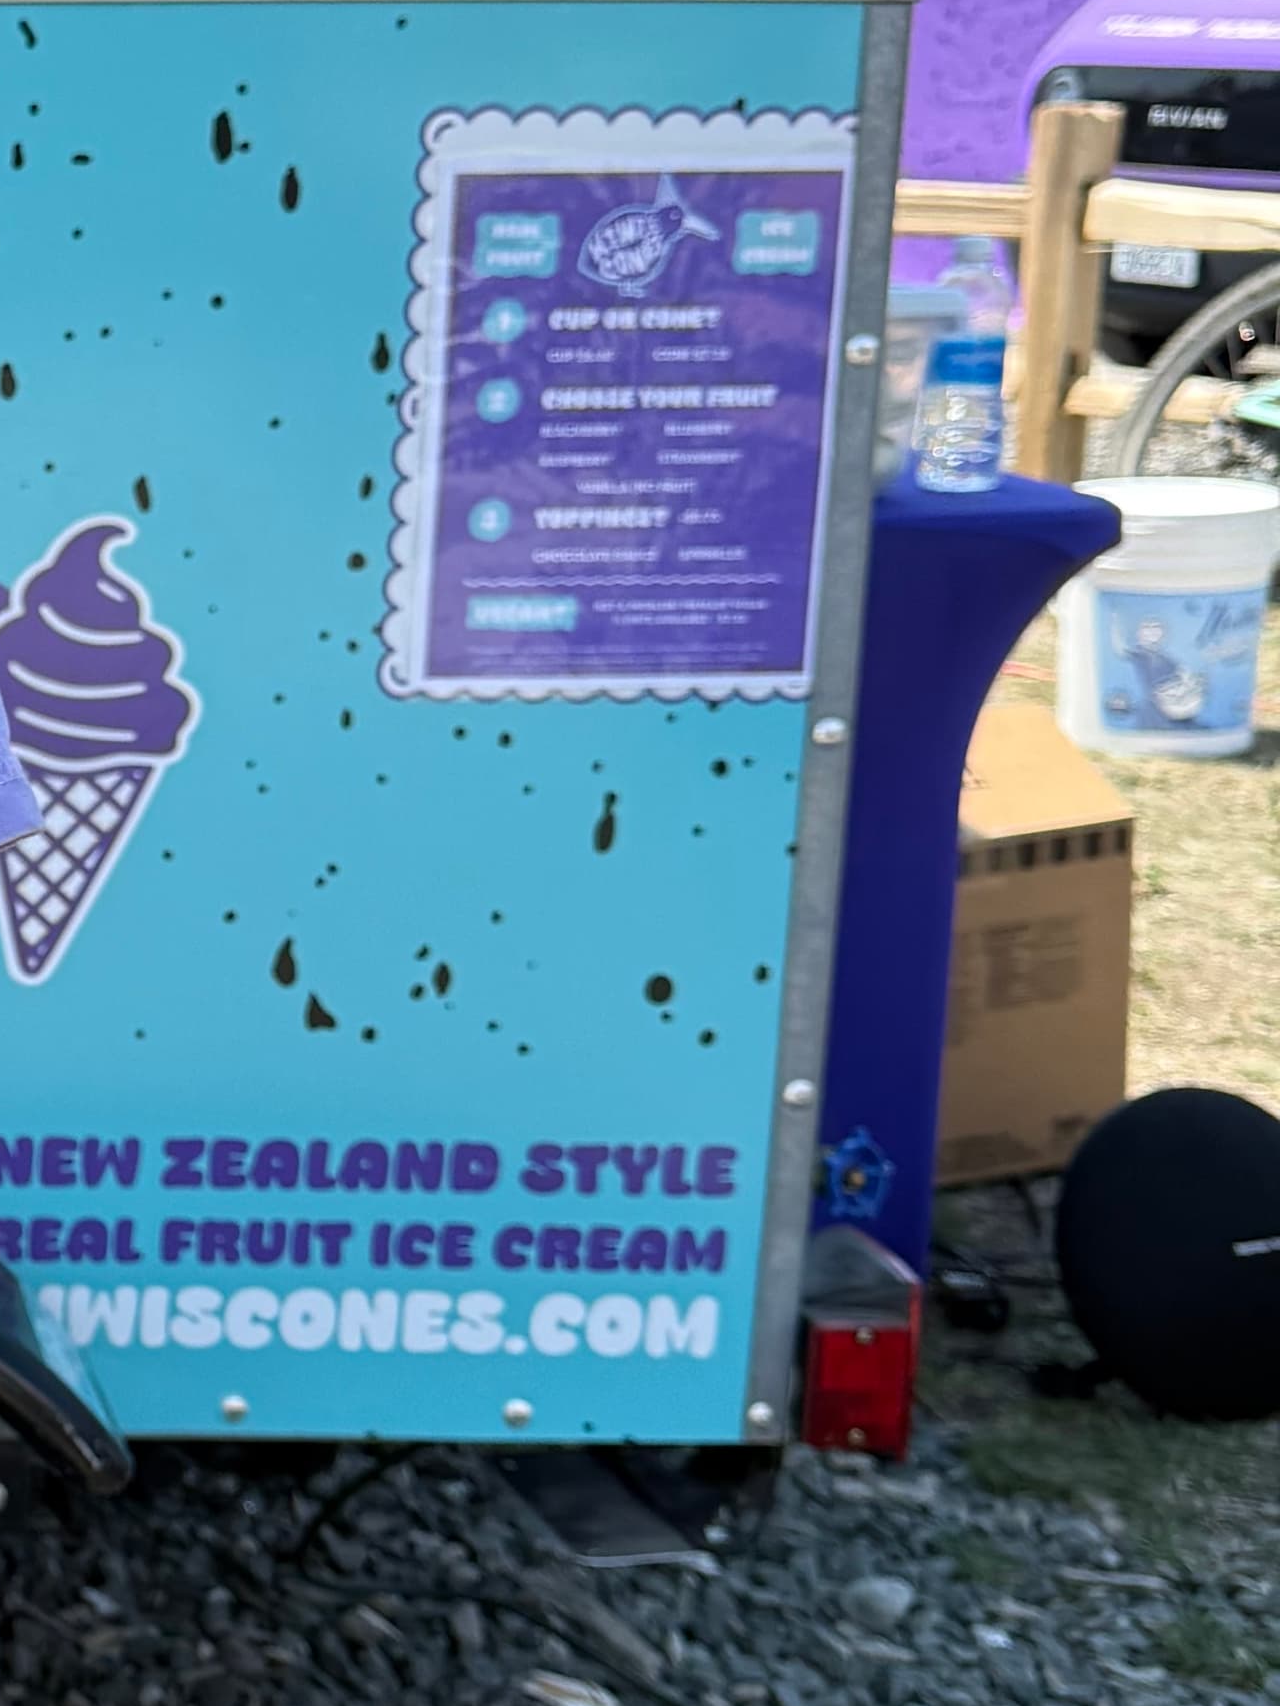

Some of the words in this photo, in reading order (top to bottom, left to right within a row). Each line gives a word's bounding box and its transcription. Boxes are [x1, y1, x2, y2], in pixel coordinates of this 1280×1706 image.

[160, 1139, 500, 1193] ZEALAND
[520, 1144, 738, 1197] STYLE
[160, 1219, 351, 1269] FRUIT
[371, 1222, 473, 1270] ICE
[493, 1225, 727, 1274] CREAM
